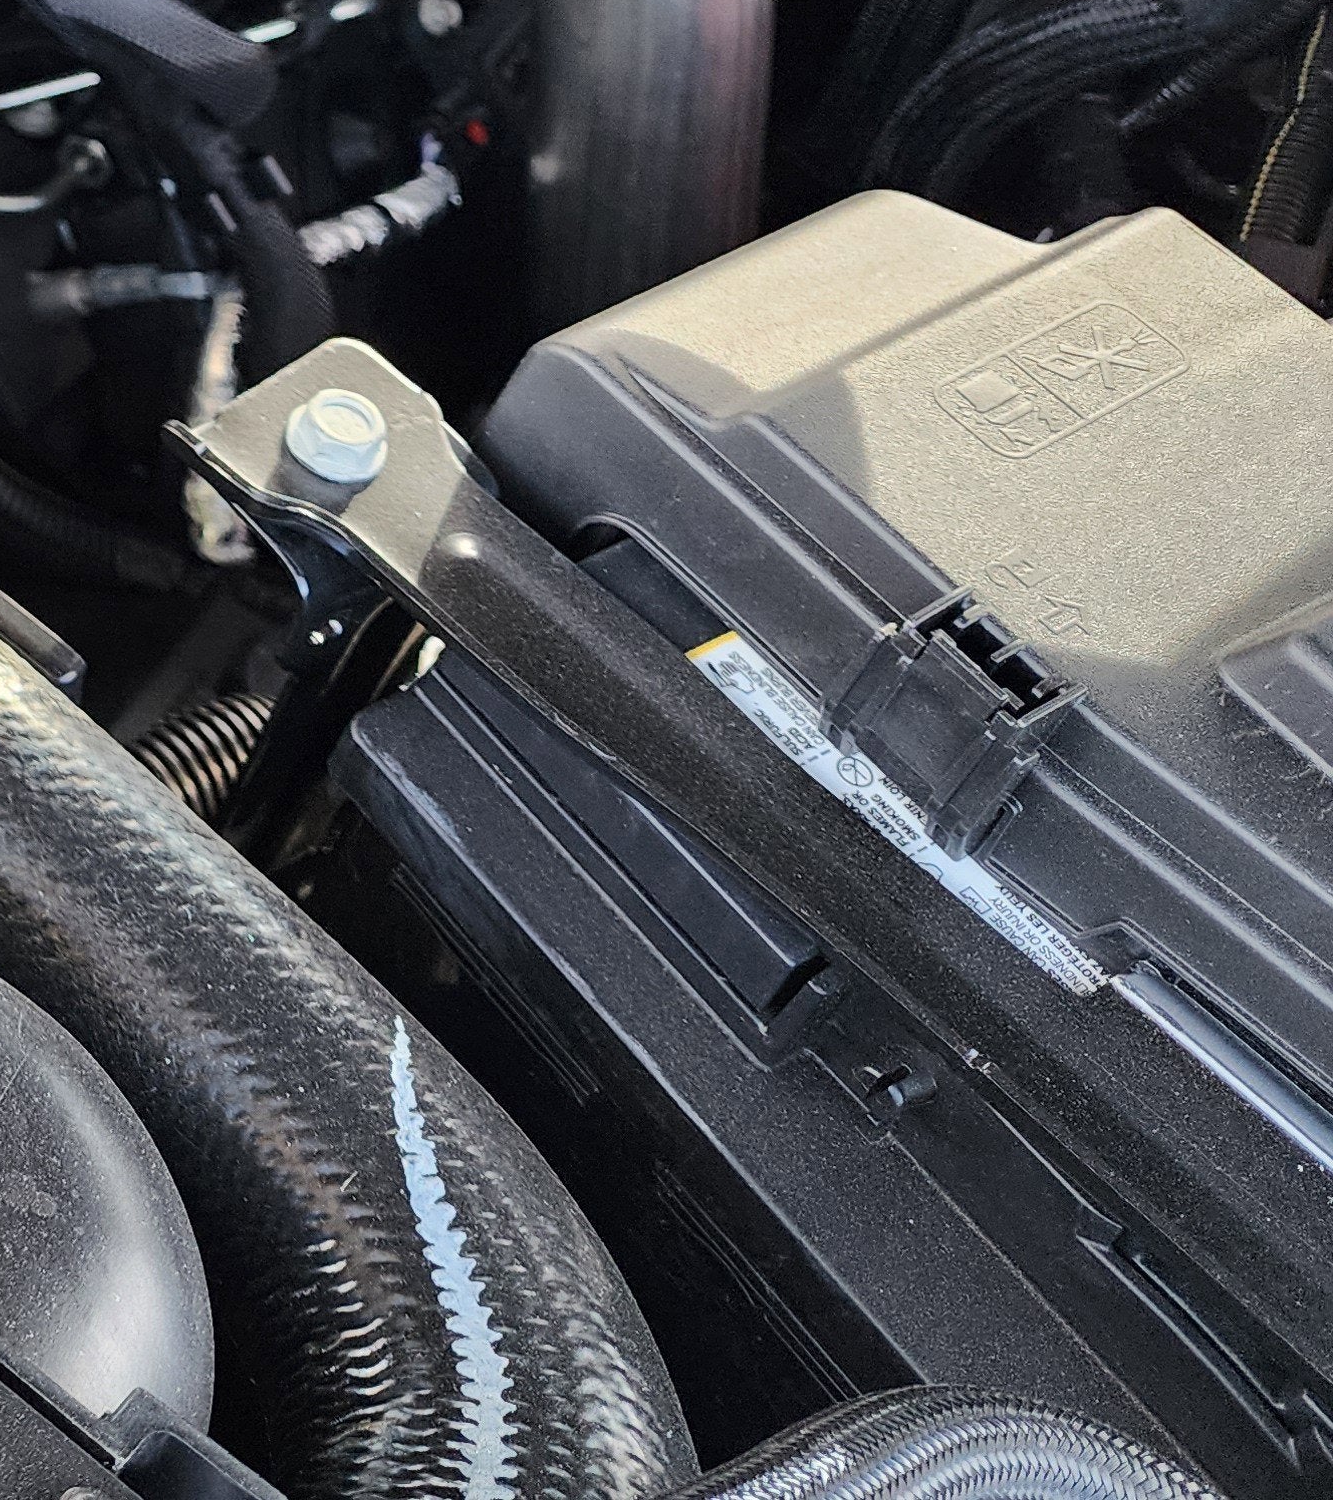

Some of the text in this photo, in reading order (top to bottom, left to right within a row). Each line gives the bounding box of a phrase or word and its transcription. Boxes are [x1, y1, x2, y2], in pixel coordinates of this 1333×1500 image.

[850, 790, 869, 806] OR
[866, 806, 909, 847] FLAMES
[869, 792, 921, 841] SMOKING
[988, 897, 1026, 930] INJURY
[1026, 912, 1049, 934] LES
[988, 912, 1026, 947] CAUSE
[1022, 928, 1042, 946] OR
[1022, 945, 1047, 967] CAN
